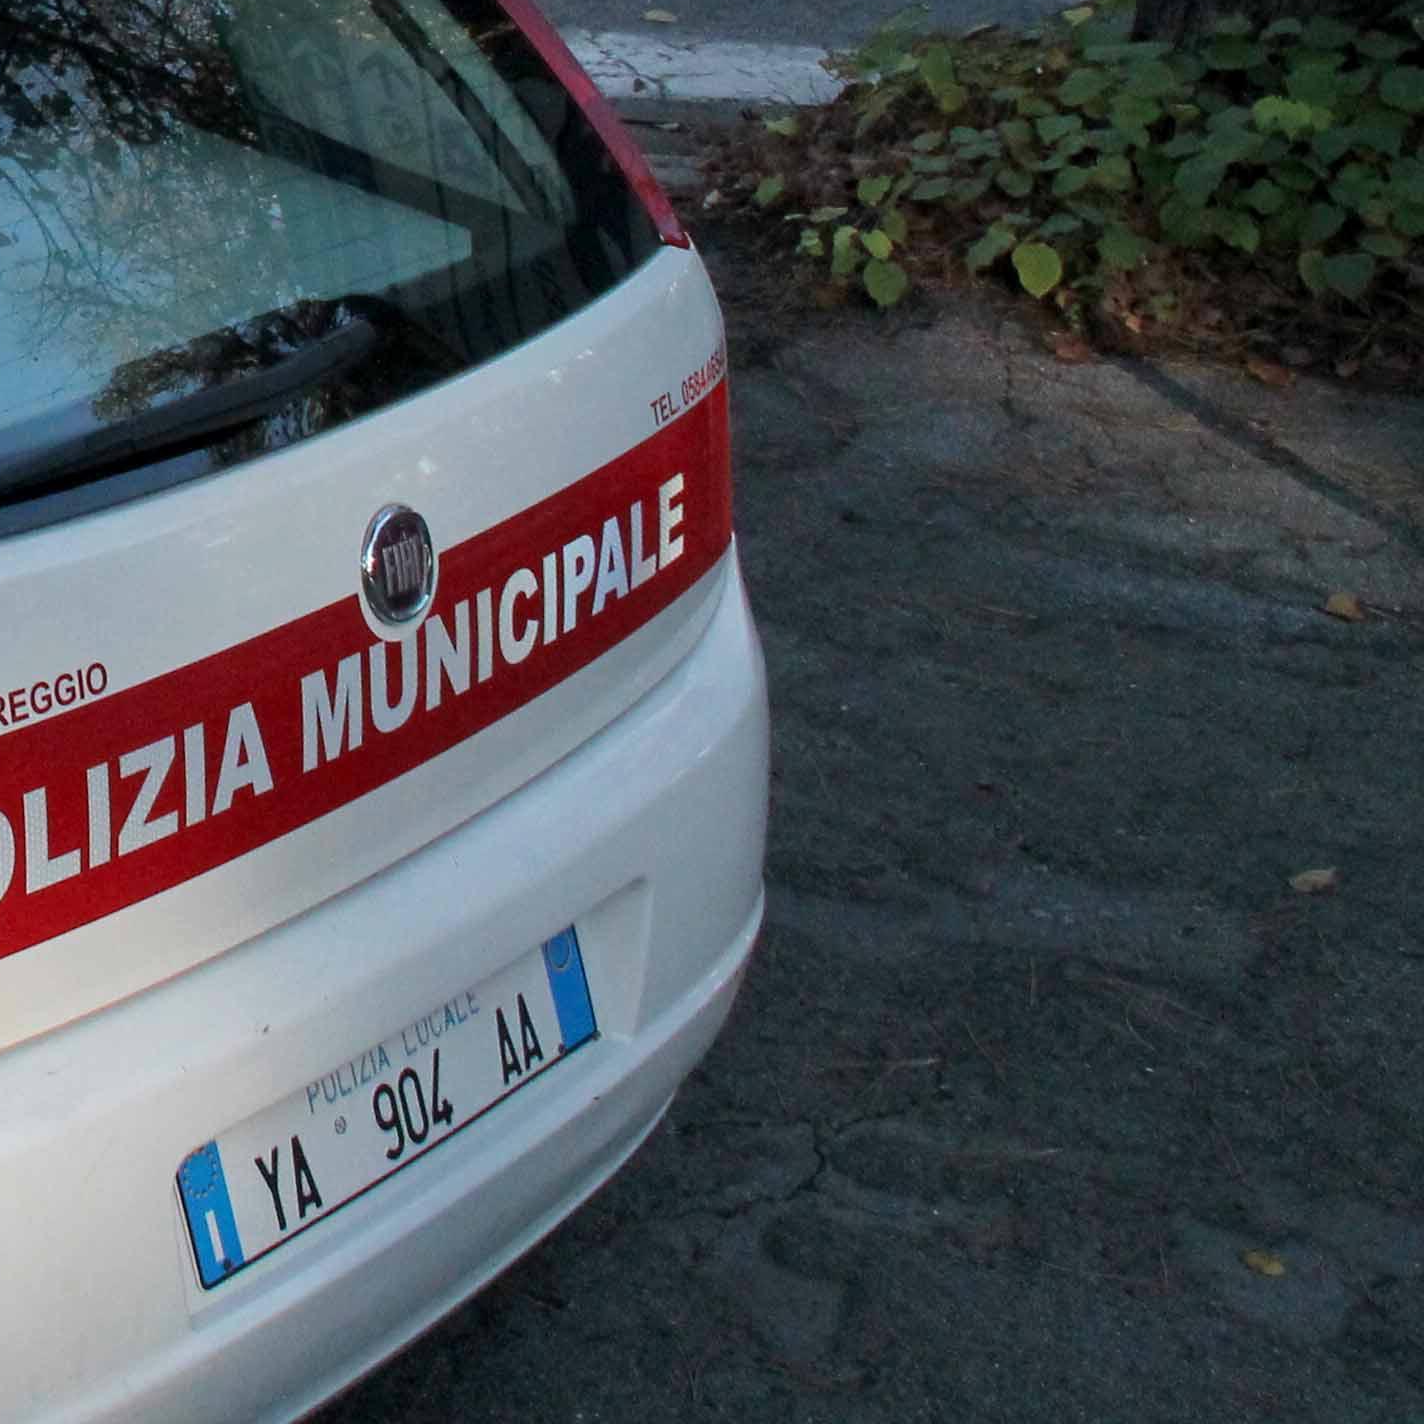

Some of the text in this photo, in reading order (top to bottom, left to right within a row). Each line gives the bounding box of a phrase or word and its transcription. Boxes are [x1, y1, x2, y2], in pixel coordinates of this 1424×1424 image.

[300, 472, 684, 774] MUNICIPALE
[254, 1135, 323, 1232] YA
[371, 1047, 454, 1161] 904
[496, 992, 545, 1084] AA
